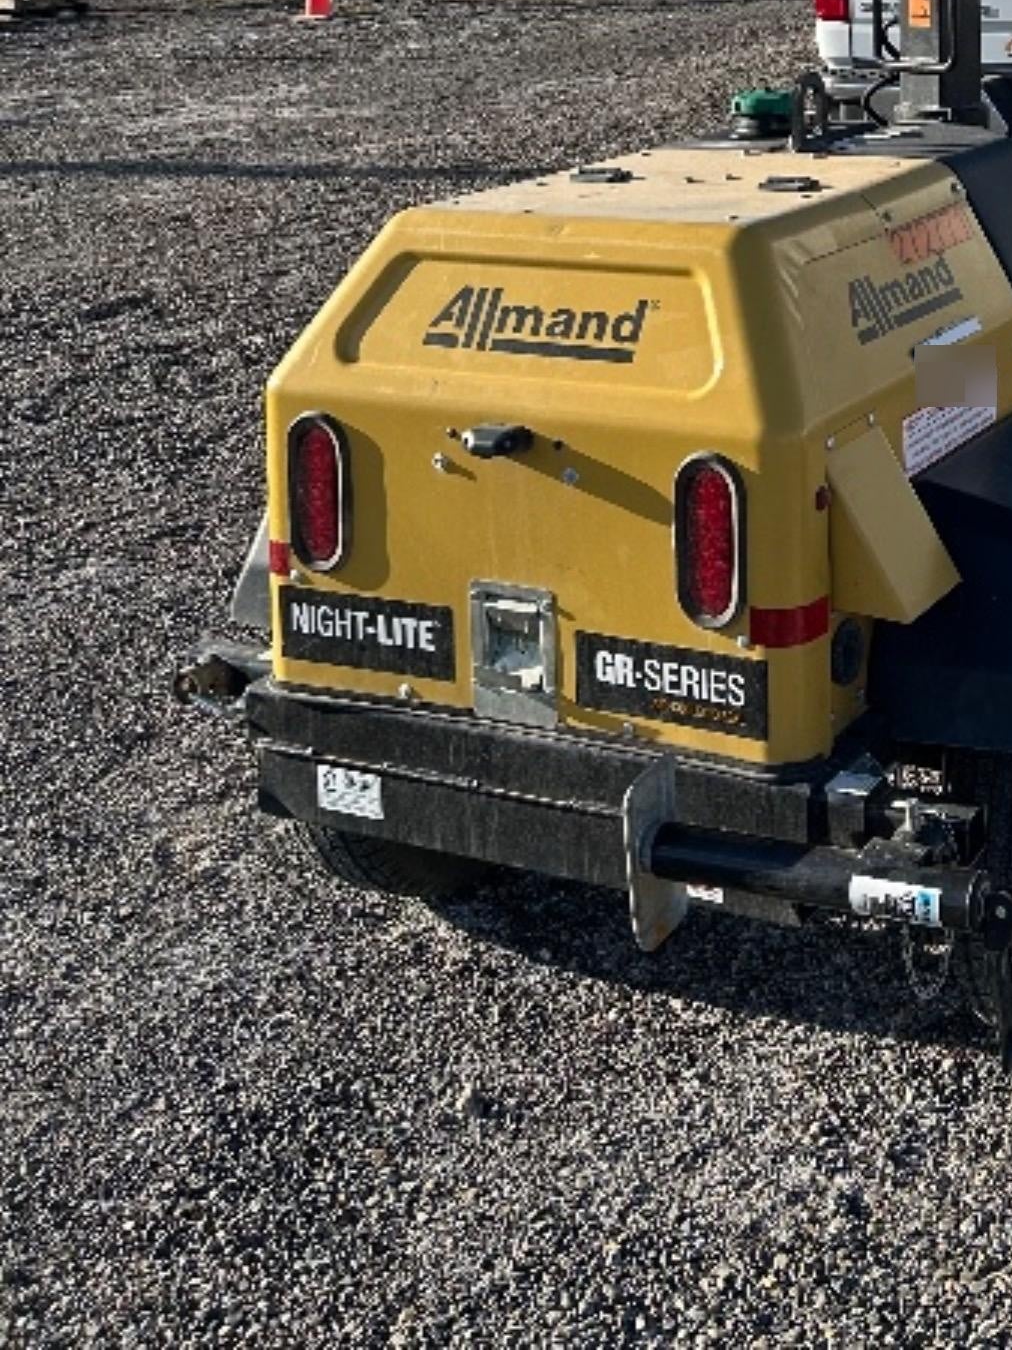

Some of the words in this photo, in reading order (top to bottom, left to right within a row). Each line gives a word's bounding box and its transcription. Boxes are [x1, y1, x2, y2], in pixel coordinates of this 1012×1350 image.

[429, 284, 650, 352] Allmand
[848, 256, 955, 336] Allmand
[290, 601, 437, 652] NIGHT-LITE
[595, 650, 746, 707] GR-SERIES
